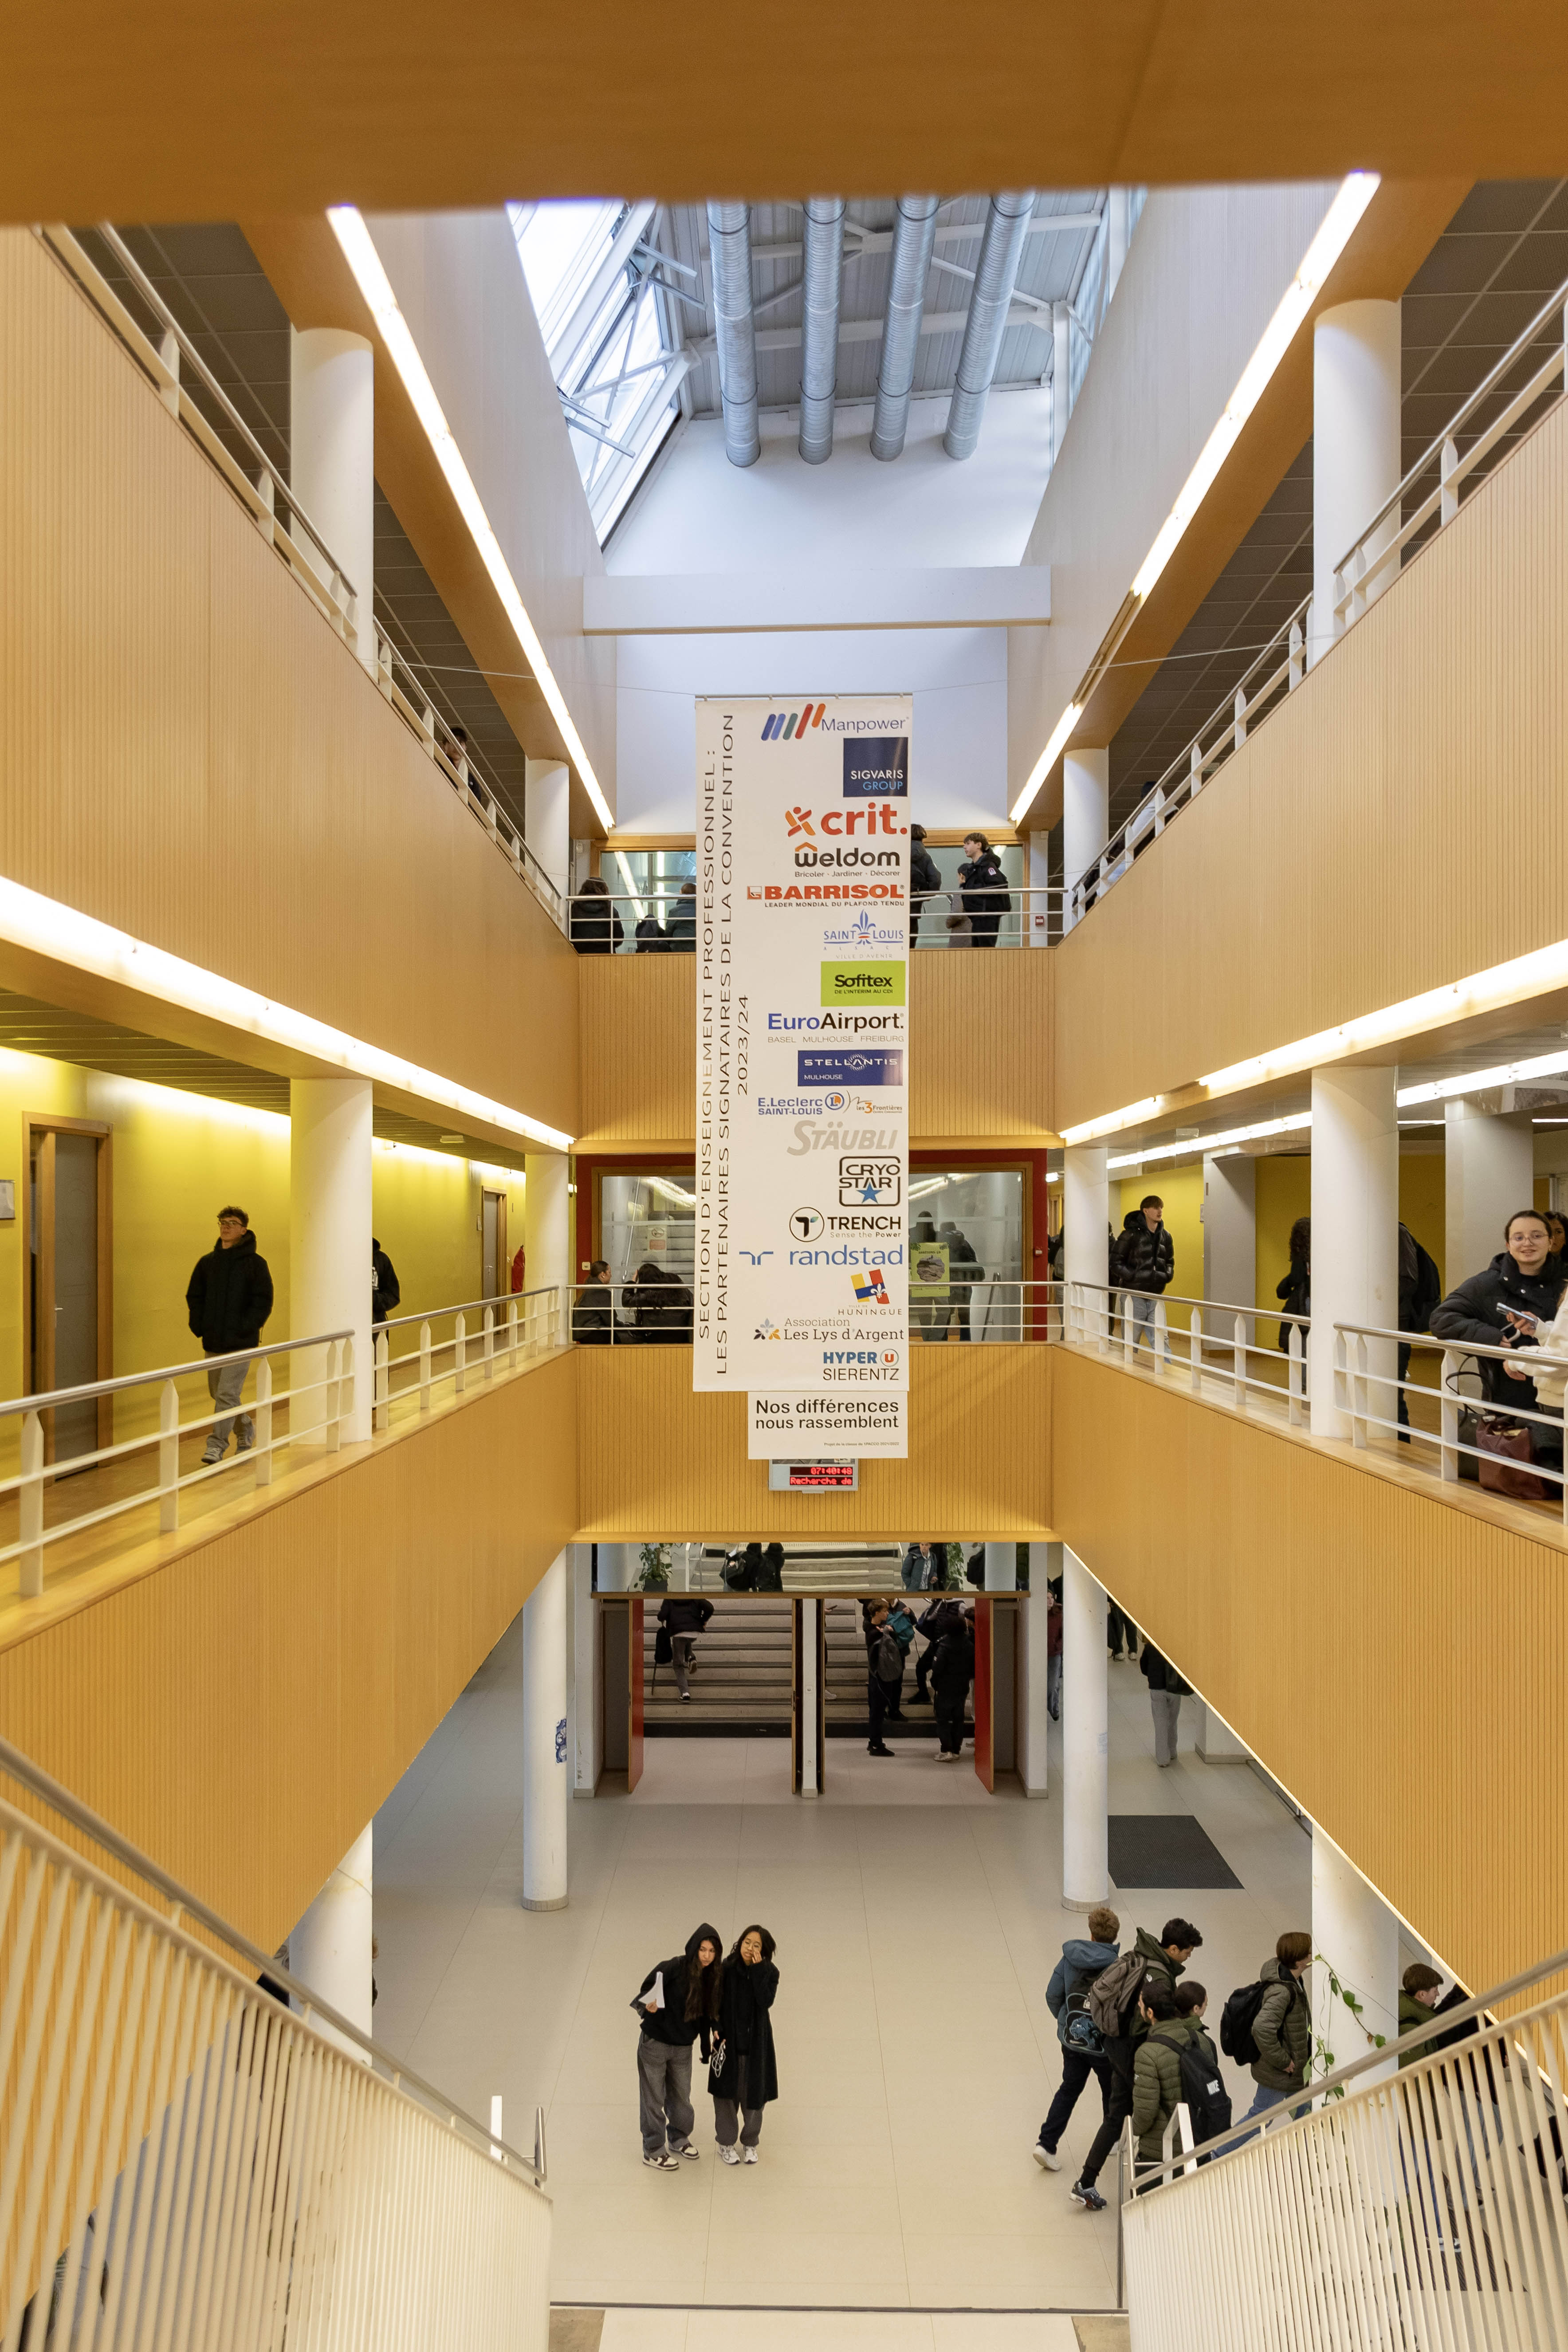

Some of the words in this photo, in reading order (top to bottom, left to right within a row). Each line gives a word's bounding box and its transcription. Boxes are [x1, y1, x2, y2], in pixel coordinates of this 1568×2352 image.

[821, 718, 906, 733] Manpower
[851, 769, 903, 780] SIGVARIS
[863, 780, 903, 791] GROUP
[722, 715, 733, 885] CONVENTION
[821, 802, 908, 836] crit.
[794, 847, 900, 868] weldom
[703, 763, 715, 979] PROFESSIONNEL
[764, 884, 904, 900] BARRISOL
[721, 893, 731, 922] LA
[824, 930, 857, 940] SAINT
[873, 930, 904, 939] LOUIS
[721, 932, 731, 964] DE
[834, 973, 893, 988] Sofitex
[768, 1012, 904, 1033] EuroAirport.
[737, 995, 750, 1095] 2023/24
[719, 973, 731, 1139] SIGNATAIRES
[804, 1058, 899, 1067] STELLANTIS
[701, 989, 712, 1218] D'ENSEIGNEMENT
[758, 1097, 823, 1107] E.Leclerc
[864, 1102, 873, 1114] 3
[786, 1120, 898, 1157] STÄUBLI
[845, 1164, 900, 1176] CRYO
[839, 1177, 892, 1189] STAR
[827, 1216, 901, 1230] TRENCH
[717, 1148, 729, 1321] PARTENAIRES
[790, 1244, 903, 1265] randstad
[699, 1229, 710, 1339] SECTION
[784, 1317, 850, 1327] Association
[784, 1329, 809, 1340] Les
[813, 1329, 837, 1343] Lys
[842, 1328, 904, 1342] d'Argent
[716, 1330, 727, 1374] LES
[823, 1352, 877, 1364] HYPER
[884, 1353, 894, 1363] U
[823, 1368, 900, 1381] SIERENTZ
[756, 1400, 790, 1414] Nos
[796, 1399, 899, 1413] différences
[756, 1419, 794, 1429] nous
[799, 1415, 899, 1428] rassemblent
[790, 1477, 837, 1485] Recherche
[1206, 2079, 1220, 2095] NIKE
